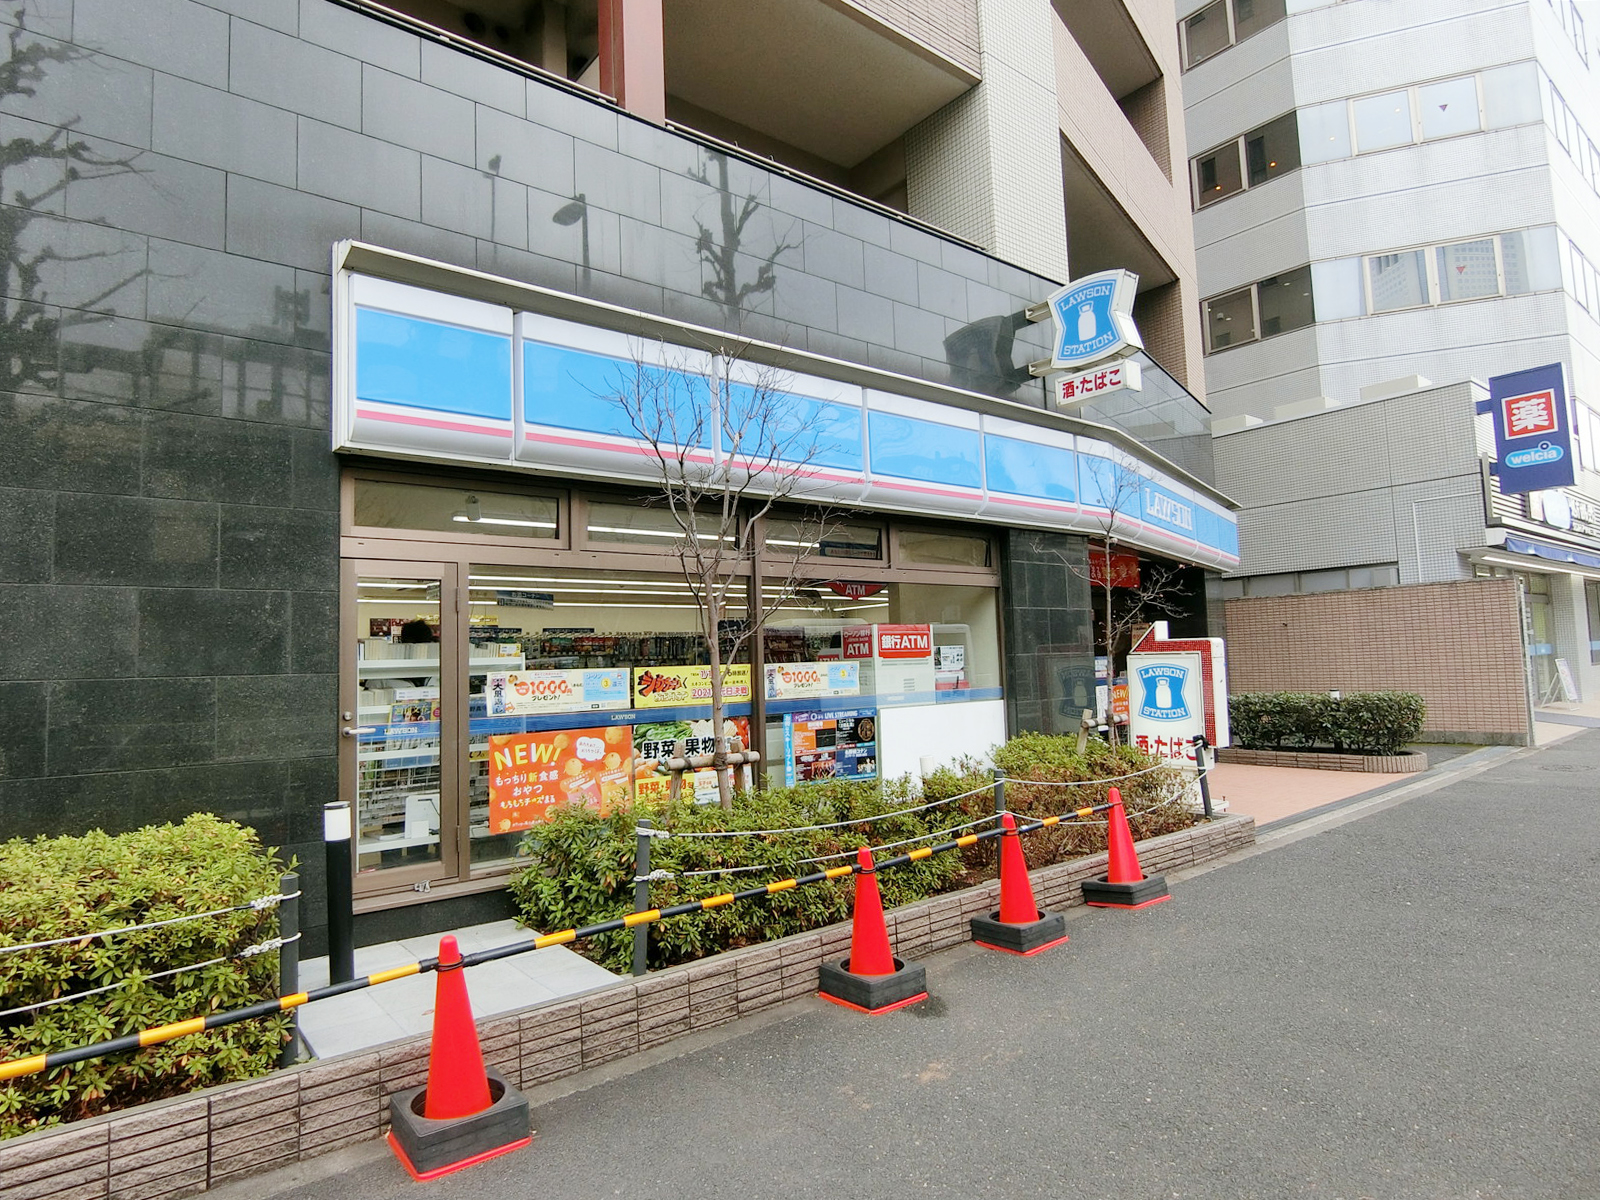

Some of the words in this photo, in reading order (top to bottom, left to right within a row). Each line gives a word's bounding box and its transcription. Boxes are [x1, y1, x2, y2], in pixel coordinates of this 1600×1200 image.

[1061, 285, 1111, 311] LAWSON
[1063, 331, 1114, 355] STATION
[1062, 368, 1122, 399] 酒・たばこ
[1510, 398, 1550, 431] 薬
[1511, 447, 1557, 464] welcia
[1144, 487, 1193, 531] LAWSON
[845, 585, 866, 596] ATM
[846, 643, 870, 656] ATM
[881, 635, 929, 649] 銀行ATM
[1141, 667, 1184, 679] LAWSON
[691, 688, 712, 697] 2021
[1143, 706, 1187, 718] STATION
[383, 726, 418, 735] LAWSON
[643, 740, 676, 759] 野菜
[685, 737, 715, 755] 果物
[494, 742, 561, 771] NEW!
[495, 770, 559, 786] もっちり新食感
[513, 785, 543, 796] おやつ
